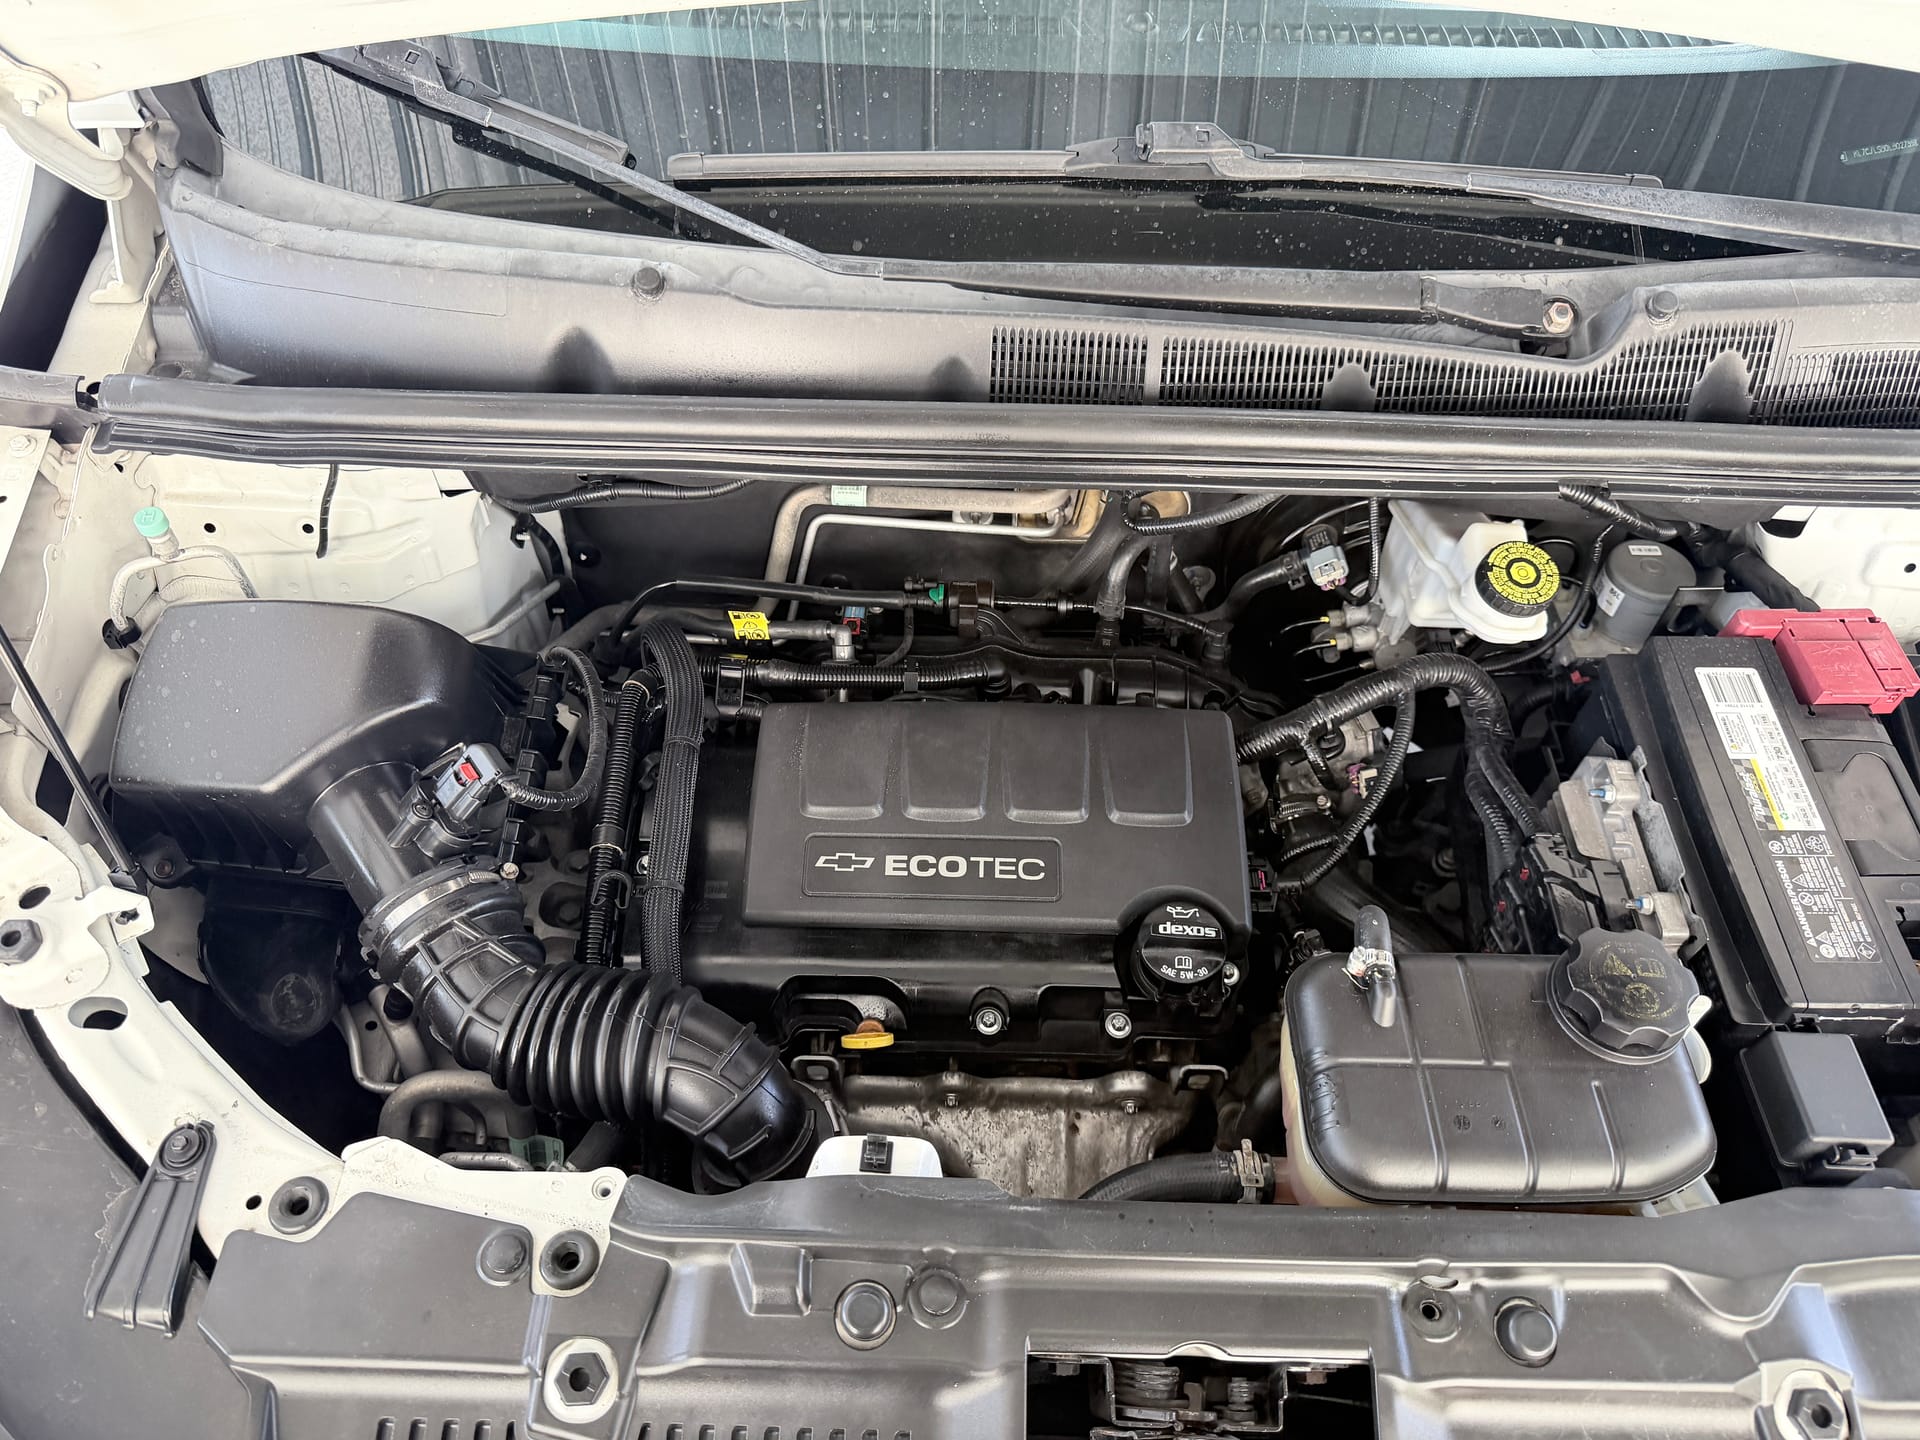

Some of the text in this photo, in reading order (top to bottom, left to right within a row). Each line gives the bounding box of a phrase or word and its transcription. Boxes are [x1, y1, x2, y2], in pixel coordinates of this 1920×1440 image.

[1772, 746, 1785, 759] 730
[1748, 773, 1761, 793] GOLD
[1737, 771, 1766, 816] Duralast
[884, 855, 1045, 881] ECOTEC
[1774, 860, 1813, 937] DANGER/POISON
[1158, 921, 1217, 938] dexos
[1160, 964, 1209, 980] SAE 5W-30
